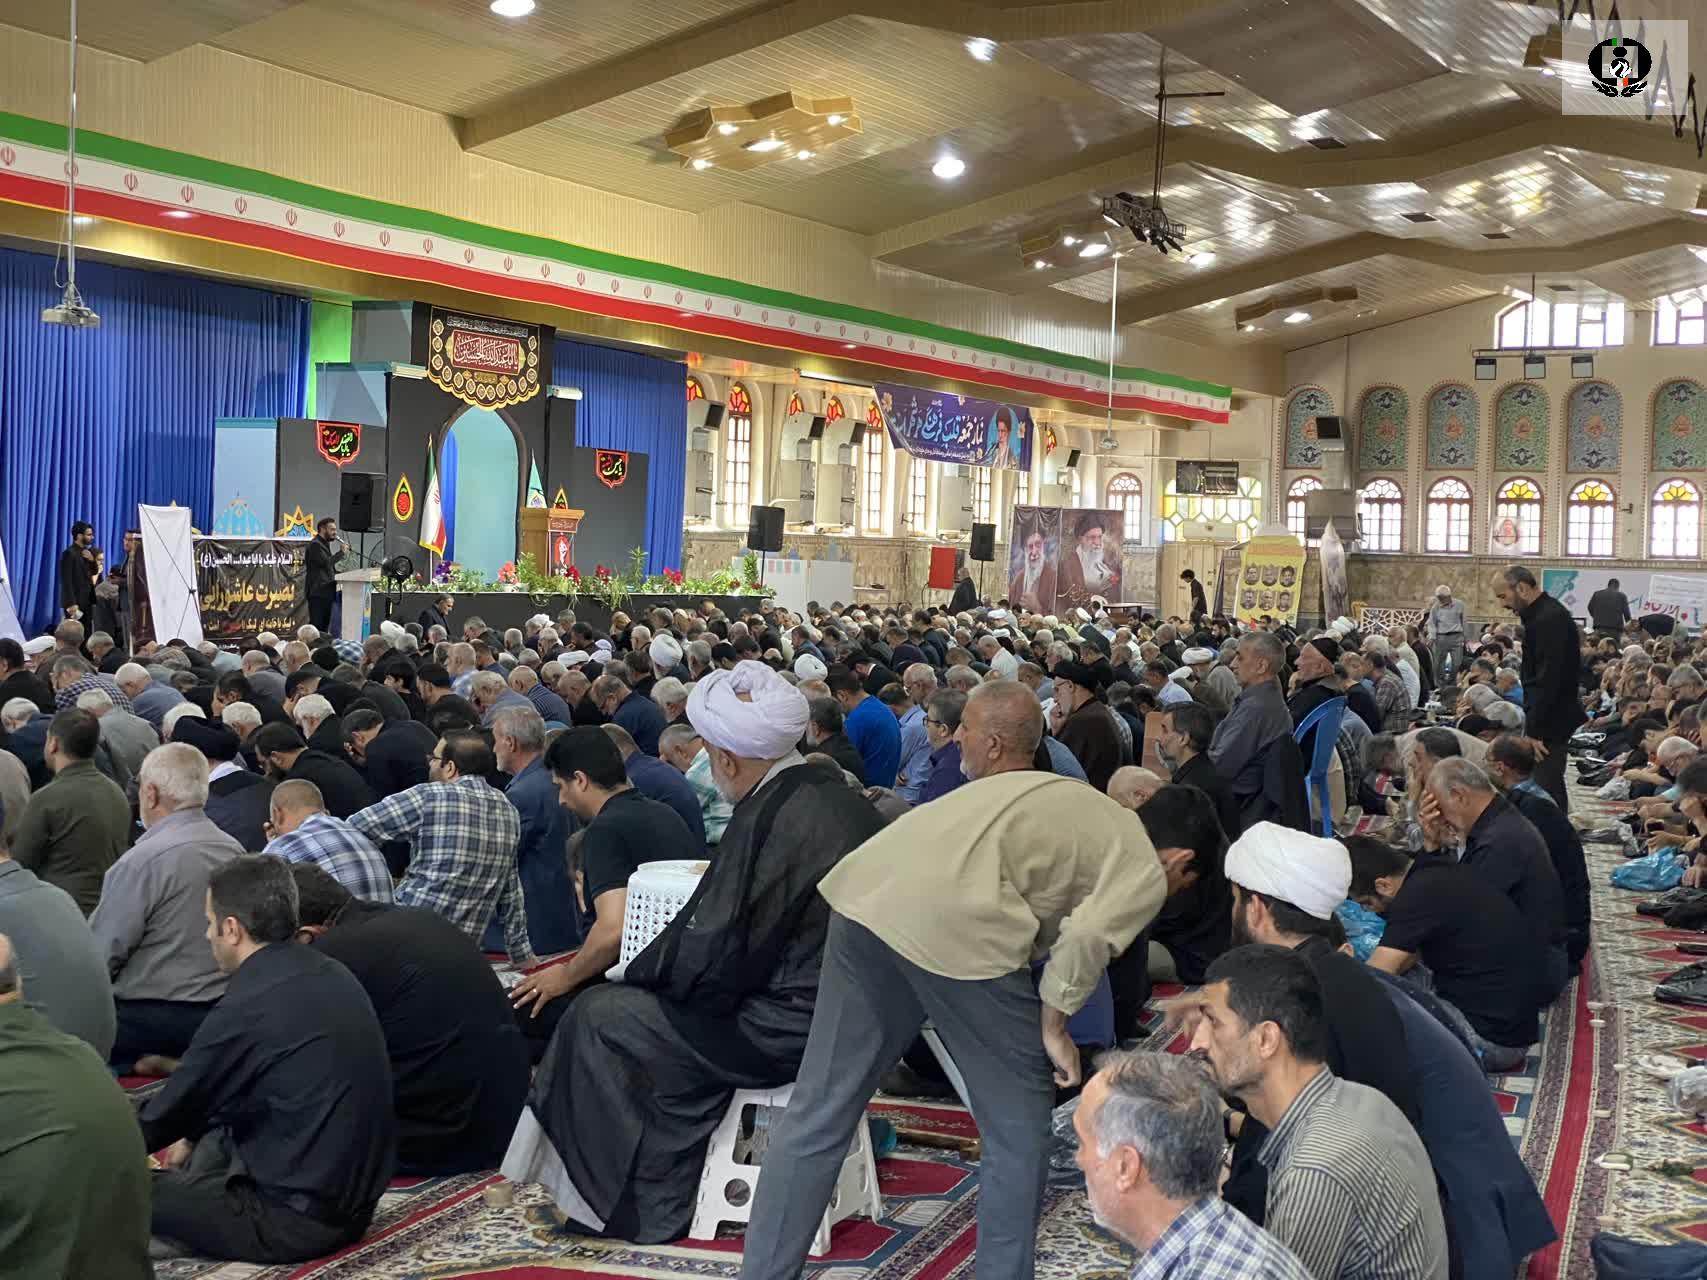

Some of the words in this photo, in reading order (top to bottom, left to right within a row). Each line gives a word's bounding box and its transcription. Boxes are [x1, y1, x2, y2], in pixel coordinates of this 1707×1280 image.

[942, 415, 962, 449] قلب
[957, 416, 974, 448] جمعه
[971, 416, 984, 445] نماز
[200, 552, 212, 568] (ع)
[263, 552, 277, 568] علیک
[277, 552, 293, 568] السلام
[255, 583, 295, 610] بصیرت
